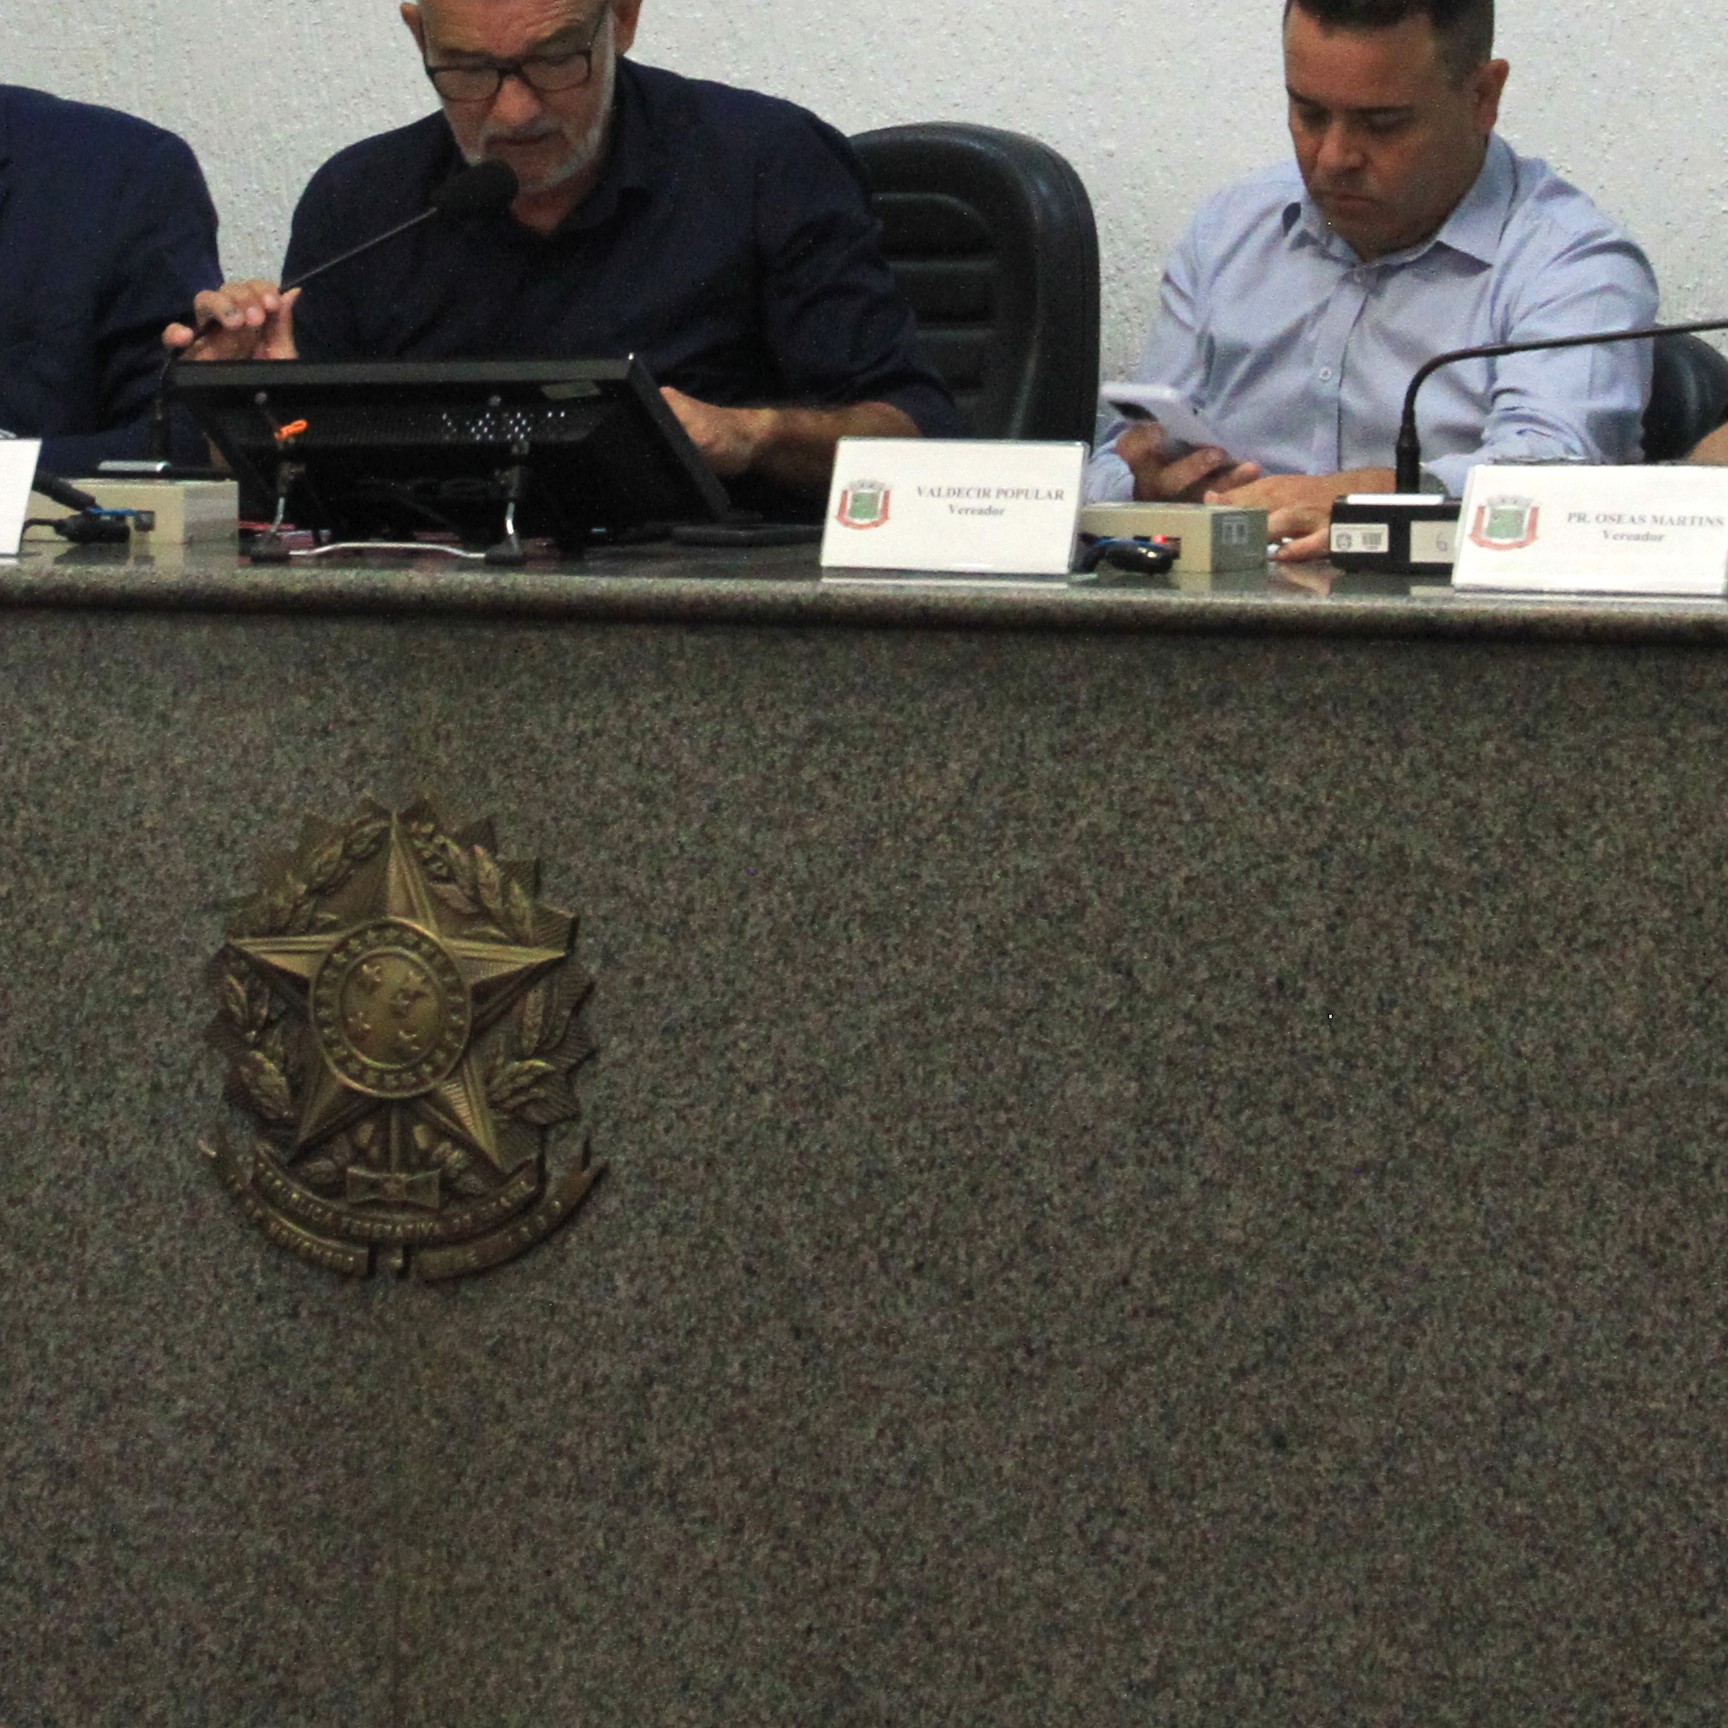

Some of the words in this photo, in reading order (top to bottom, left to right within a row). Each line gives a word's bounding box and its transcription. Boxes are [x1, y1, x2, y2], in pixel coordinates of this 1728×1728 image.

[916, 485, 992, 499] VALDECIR
[995, 487, 1065, 501] POPULAR
[947, 503, 1006, 516] Vereador
[1567, 511, 1591, 523] PR.
[1594, 512, 1648, 525] OSEAS
[1650, 514, 1726, 528] MARTINS
[1602, 529, 1666, 542] Vereador
